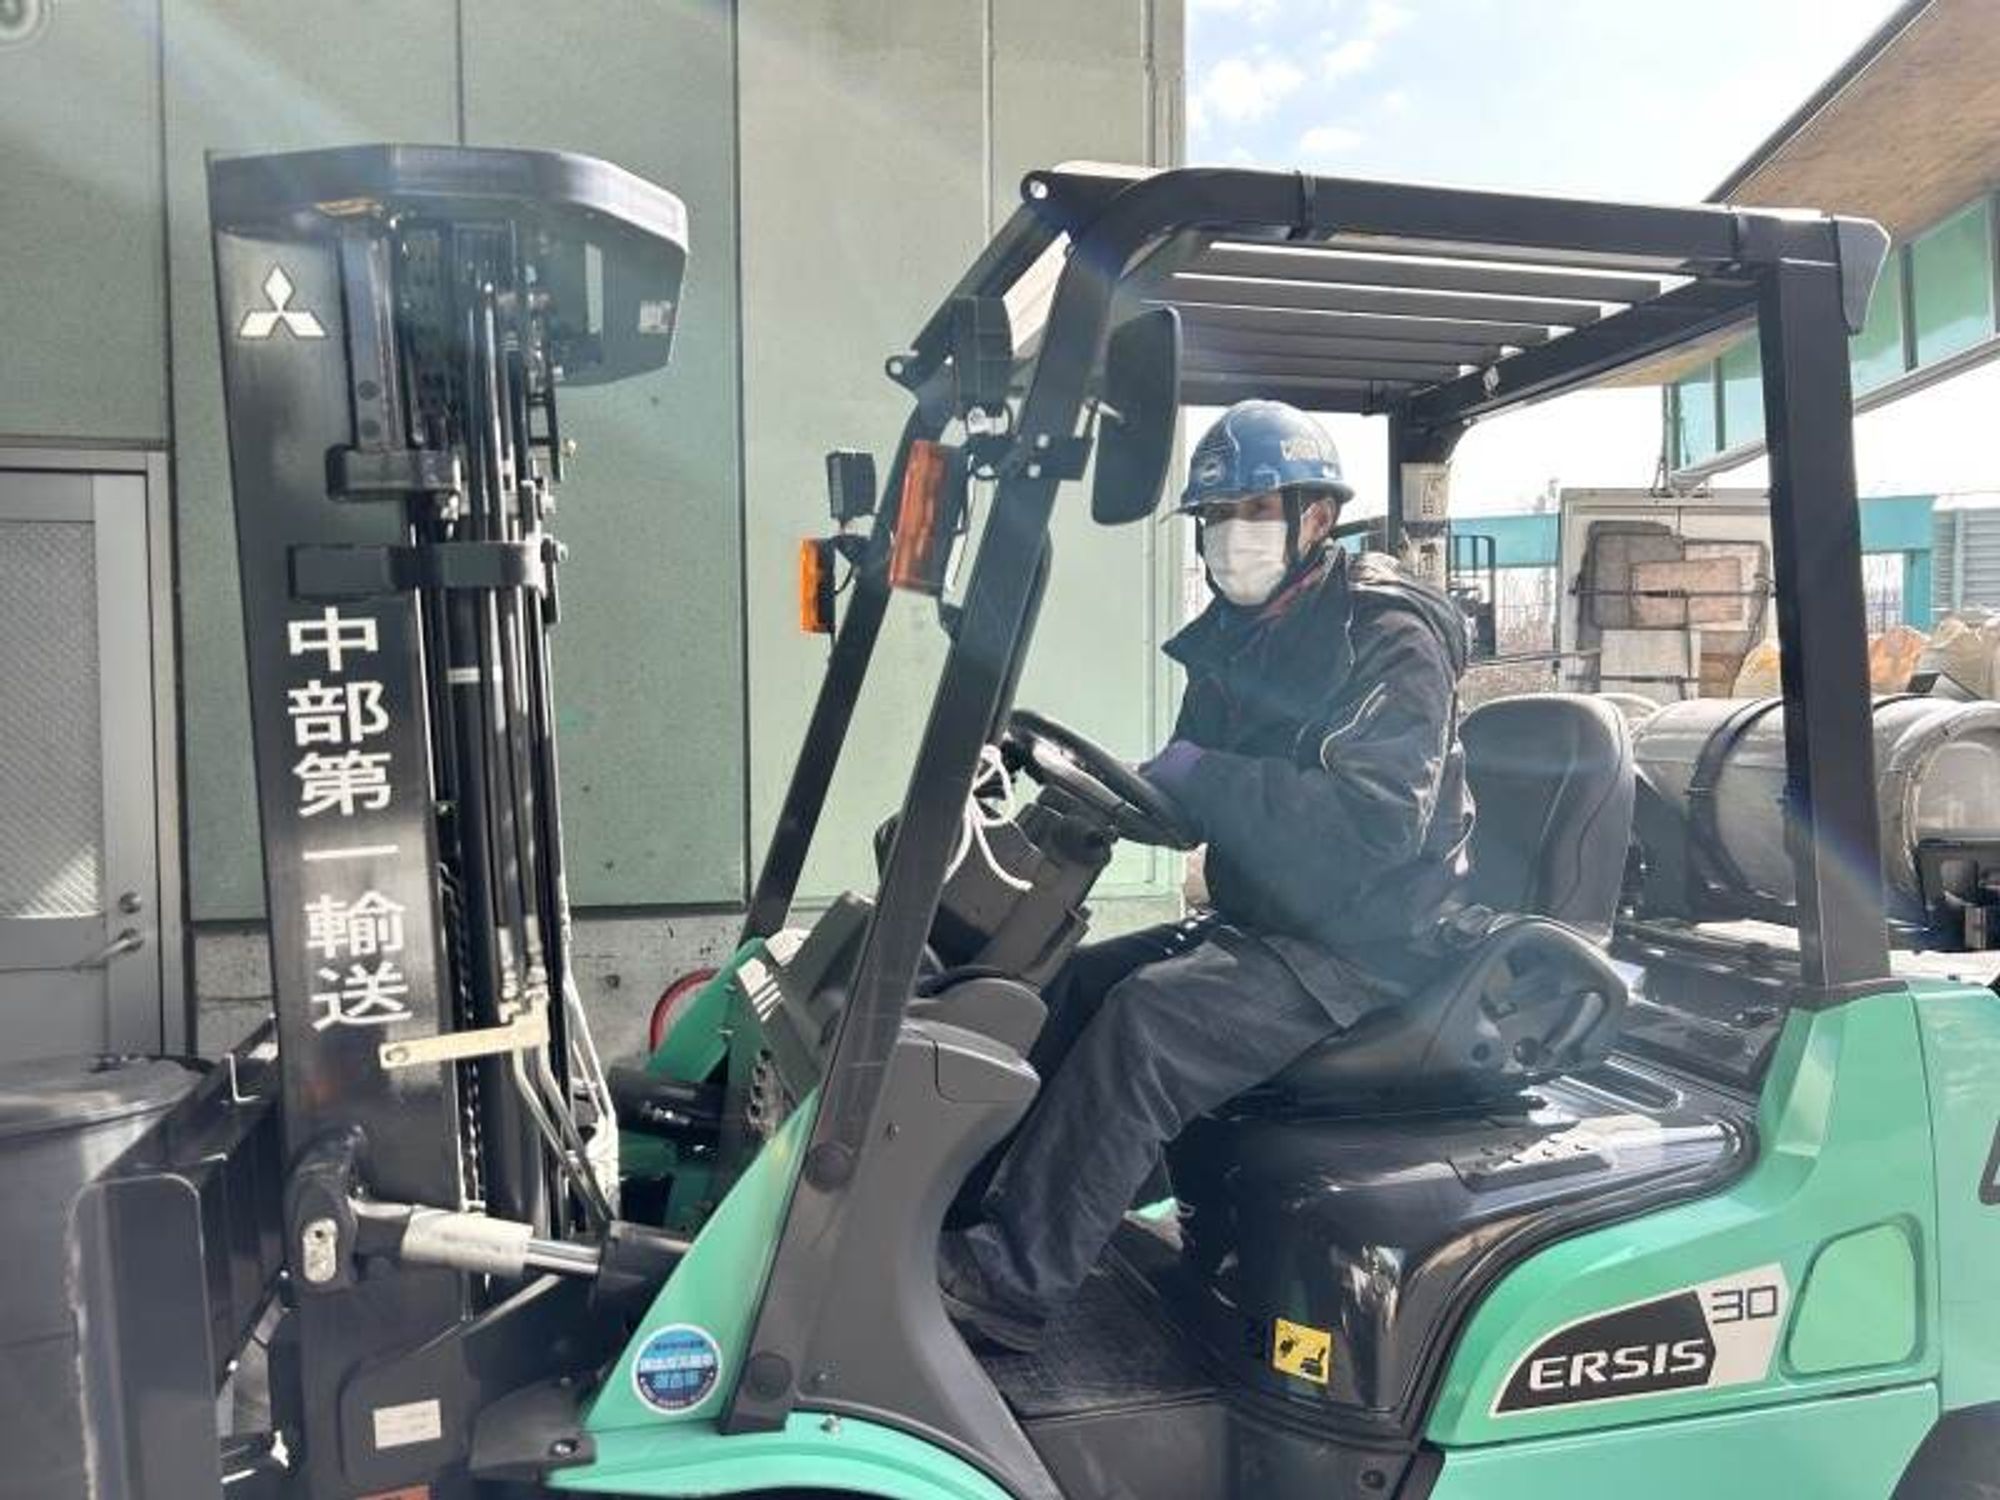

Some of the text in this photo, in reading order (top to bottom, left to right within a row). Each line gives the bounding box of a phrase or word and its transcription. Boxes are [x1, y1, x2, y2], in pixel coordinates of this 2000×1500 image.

[287, 606, 413, 1031] 中部第一輸送
[1712, 1285, 1778, 1324] 30
[1529, 1338, 1707, 1391] ERSIS
